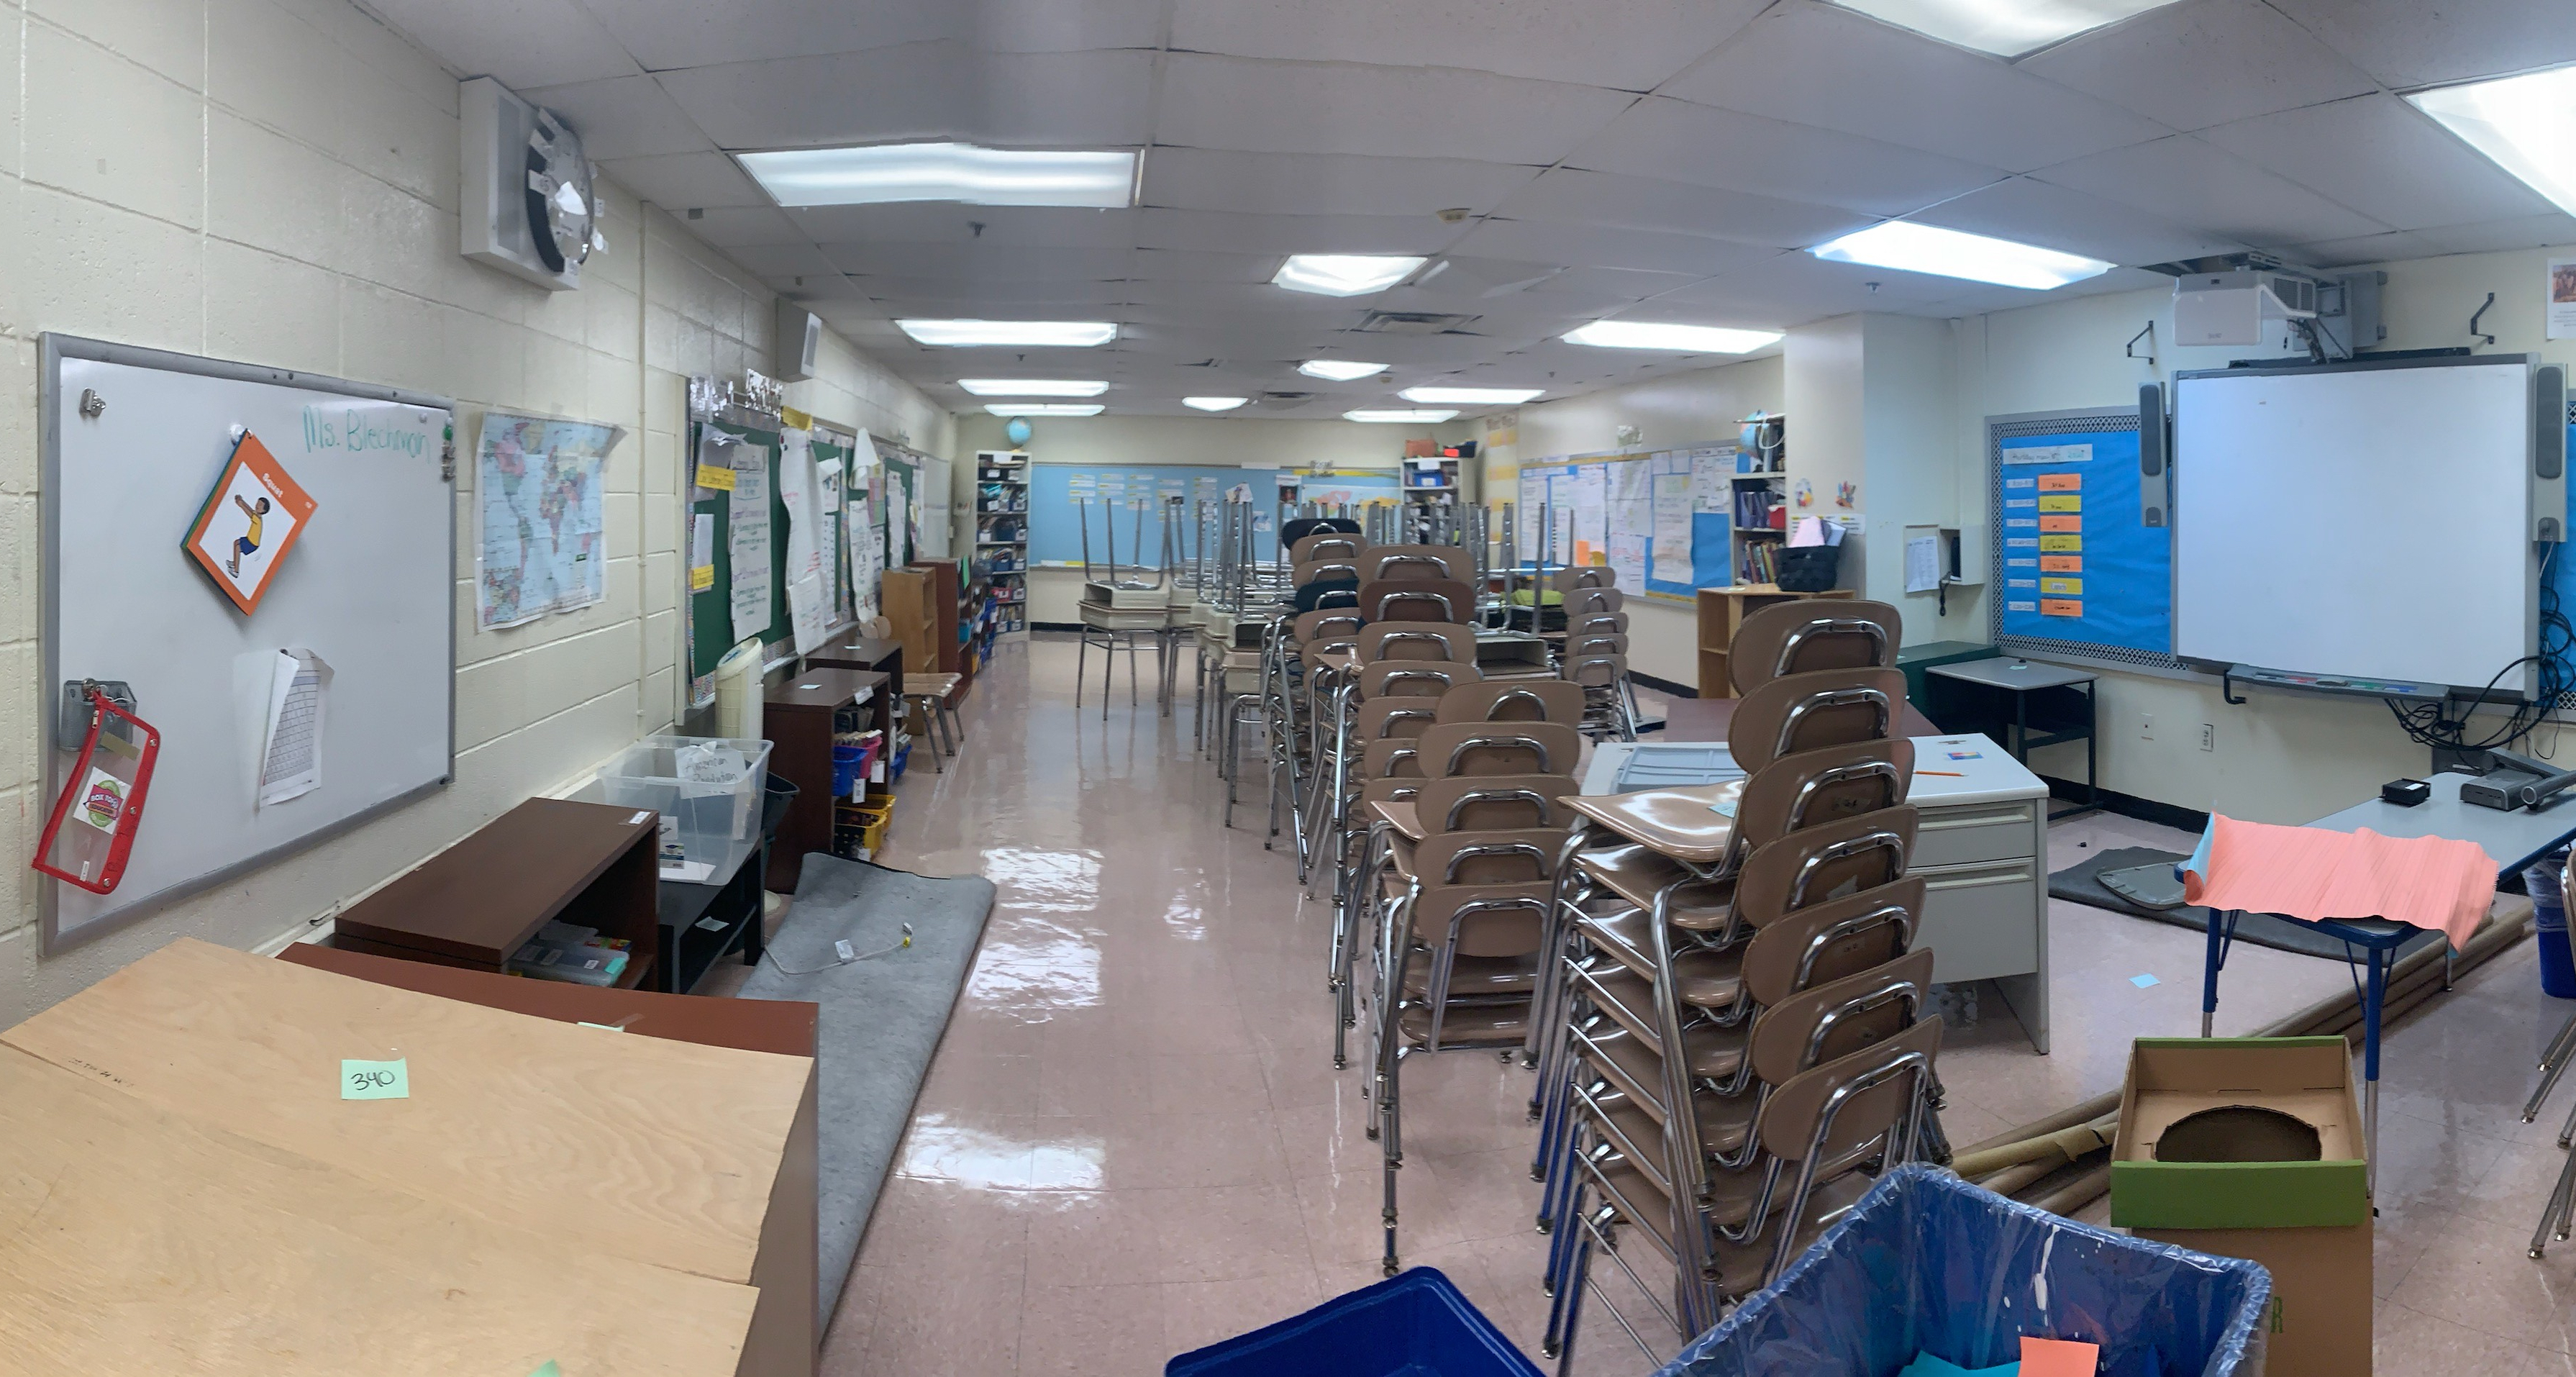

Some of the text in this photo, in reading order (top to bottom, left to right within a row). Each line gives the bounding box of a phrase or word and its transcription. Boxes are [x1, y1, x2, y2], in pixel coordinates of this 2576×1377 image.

[303, 405, 340, 453] Ms.
[262, 473, 283, 498] Squat
[350, 1070, 396, 1091] 340
